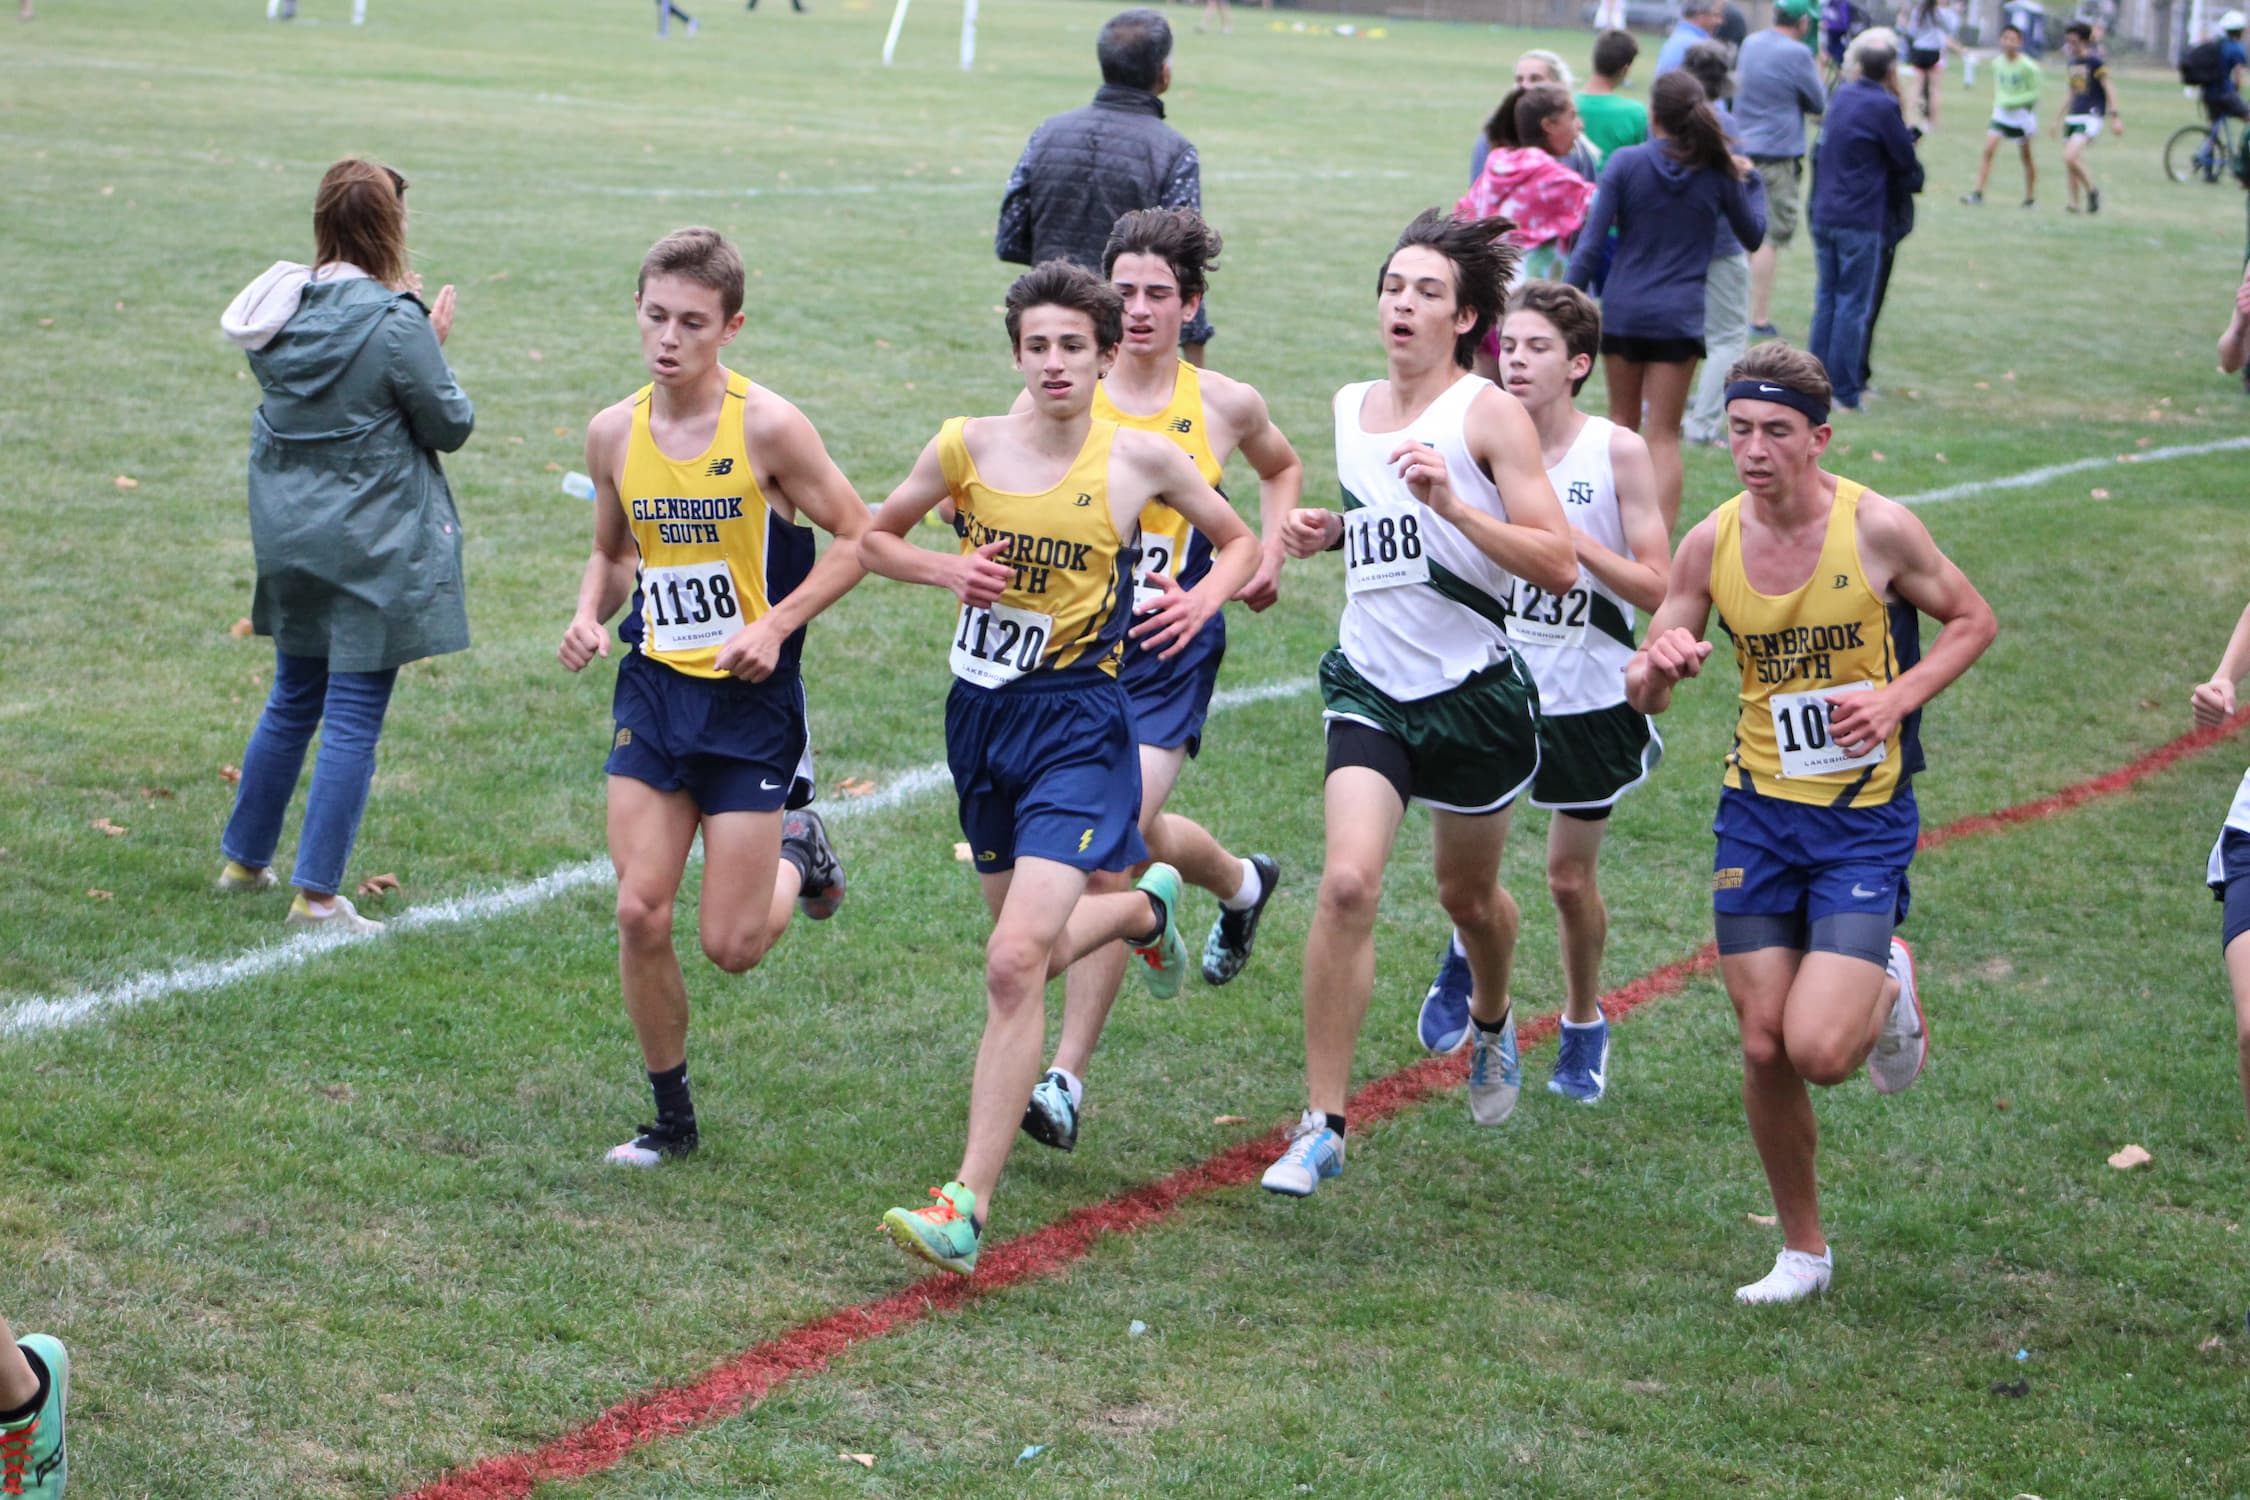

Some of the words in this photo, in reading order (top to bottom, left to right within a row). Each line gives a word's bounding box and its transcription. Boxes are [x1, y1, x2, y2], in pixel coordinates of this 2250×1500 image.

[632, 497, 744, 521] GLENBROOK
[660, 523, 720, 544] SOUTH
[1349, 514, 1422, 569] 1188
[650, 574, 737, 626] 1138
[1501, 579, 1588, 627] 1232
[672, 629, 724, 641] LAKESHORE
[957, 606, 1045, 672] 1120
[1756, 653, 1832, 684] SOUTH
[1778, 704, 1835, 752] 10
[1804, 755, 1849, 767] LAKESHO
